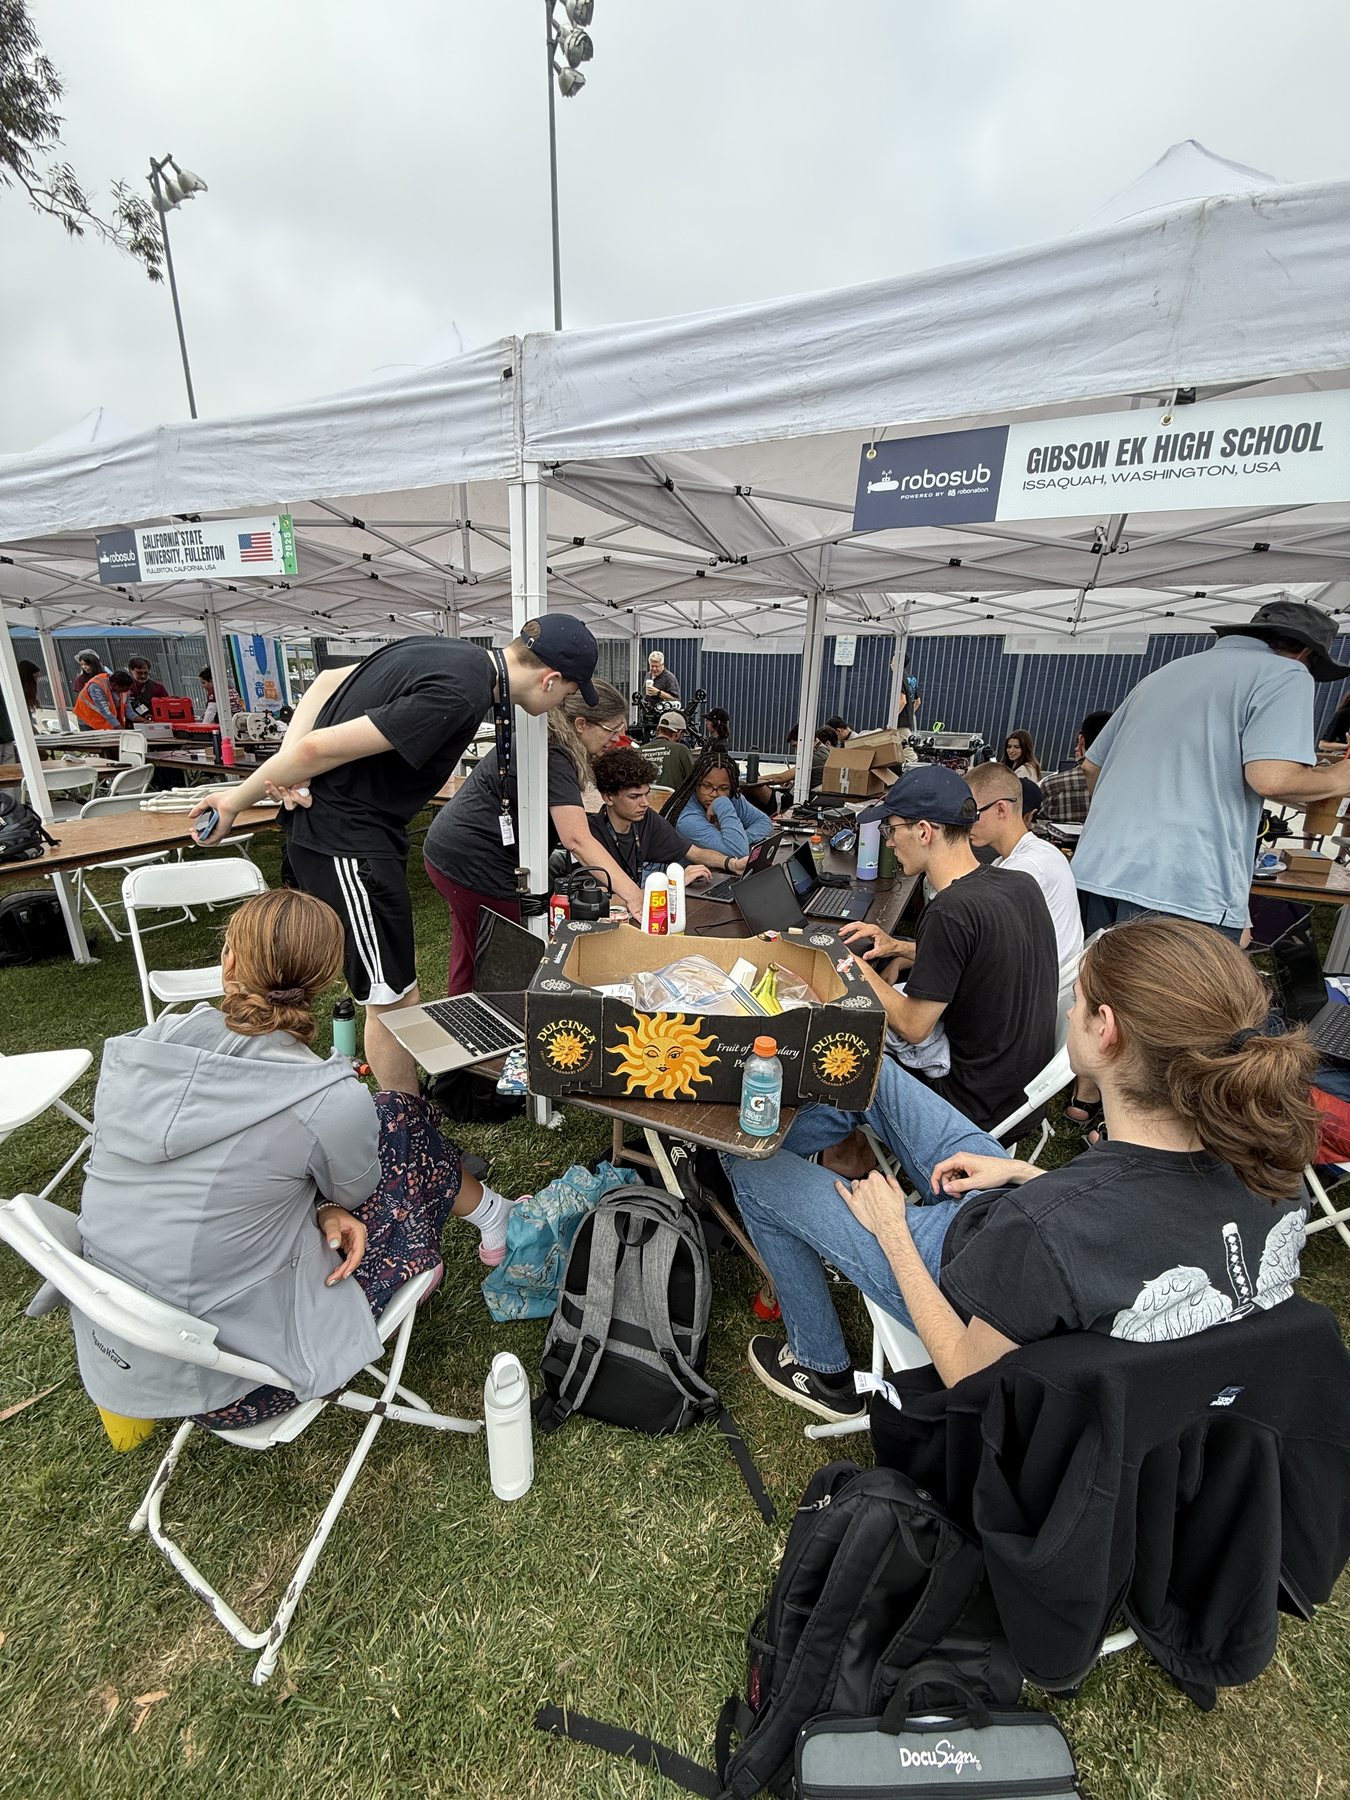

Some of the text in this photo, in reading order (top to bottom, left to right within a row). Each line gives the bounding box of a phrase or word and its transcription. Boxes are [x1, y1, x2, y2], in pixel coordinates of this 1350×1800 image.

[1026, 421, 1325, 474] GIBSON EK HIGH SCHOOL
[901, 463, 991, 491] robosub
[1022, 461, 1282, 491] ISSAQUAH, WASHINGTON, USA
[900, 492, 934, 500] POWERED
[956, 487, 989, 495] robonation
[142, 529, 204, 549] CALIFORNIA STATE
[109, 549, 136, 563] robosub
[143, 545, 226, 565] UNIVERSITY, FULLERTON
[651, 896, 667, 907] 50
[536, 1019, 596, 1045] DULCINEA
[716, 1042, 740, 1052] Fruit
[740, 1043, 753, 1057] of
[811, 1032, 870, 1058] DULCINEA
[750, 1096, 765, 1112] G
